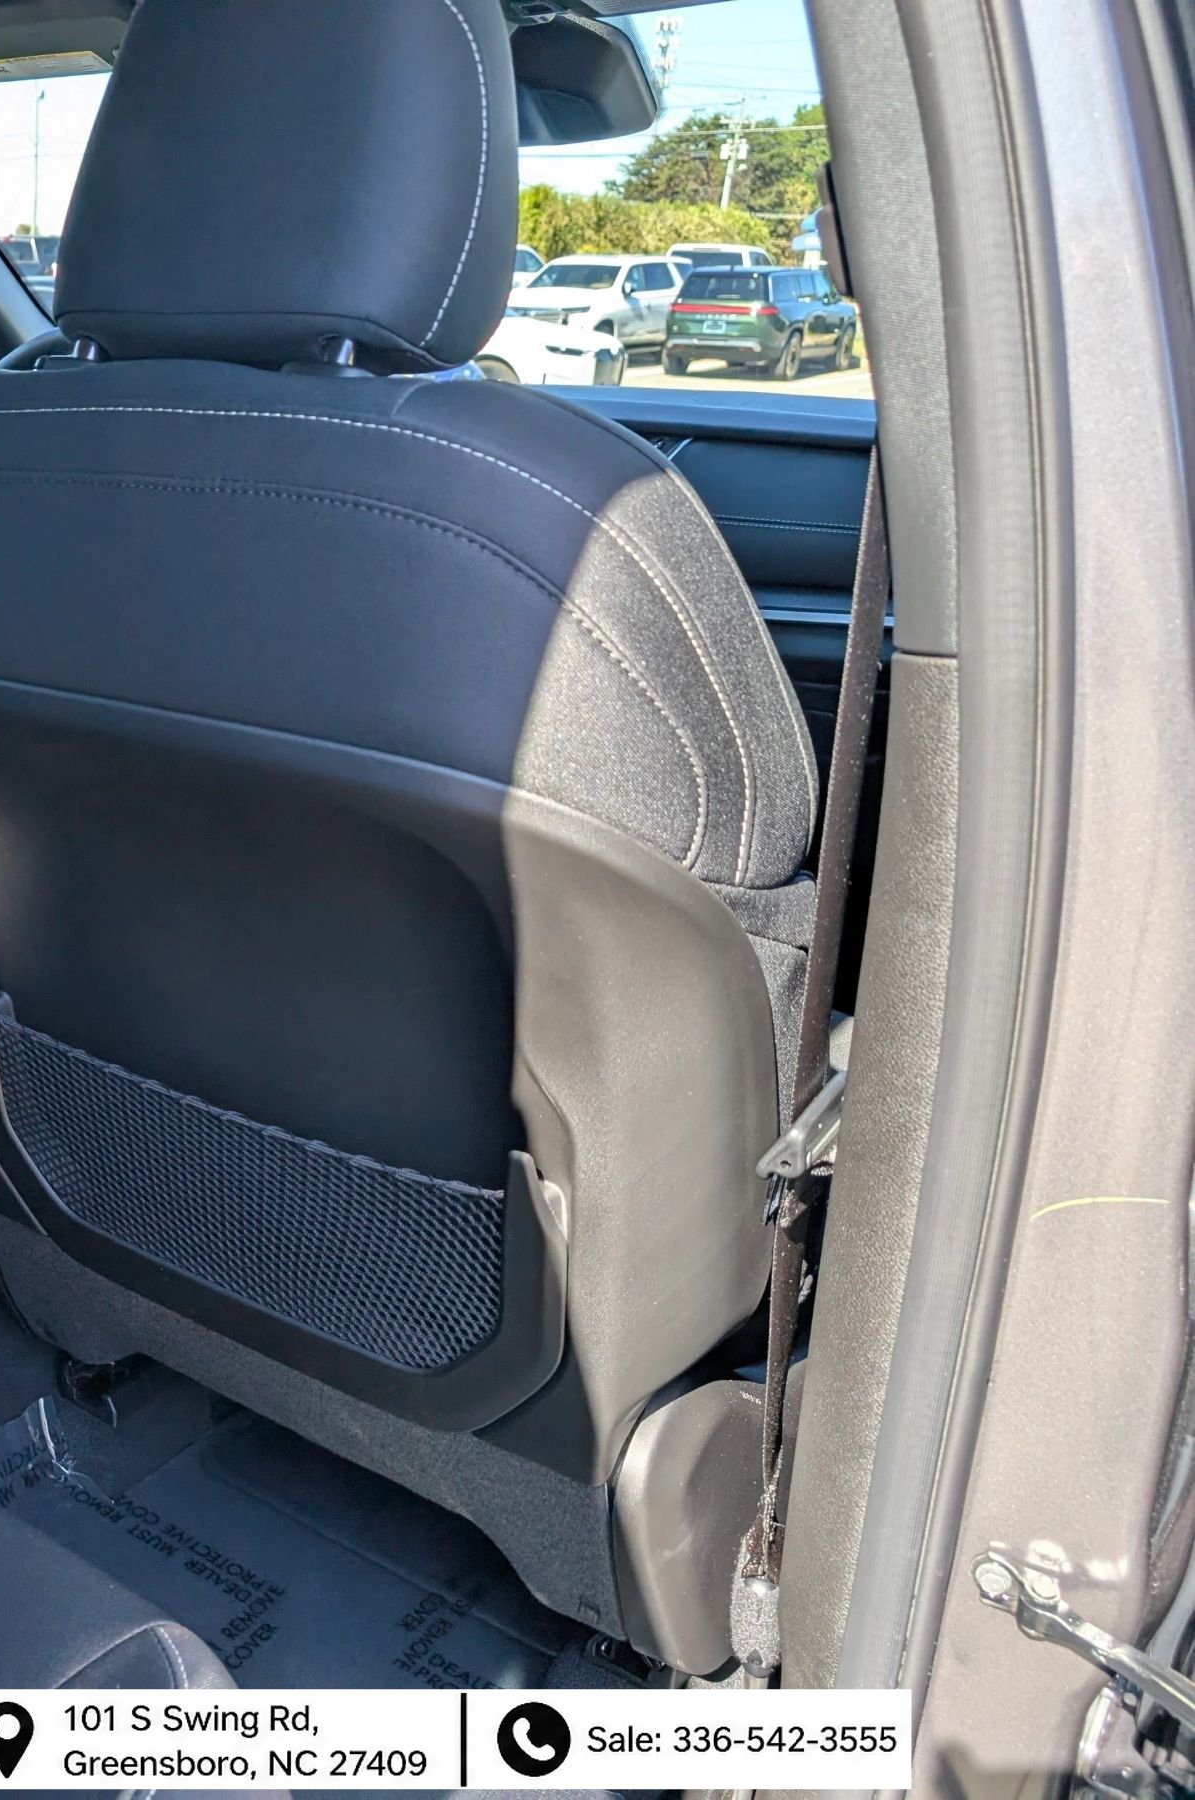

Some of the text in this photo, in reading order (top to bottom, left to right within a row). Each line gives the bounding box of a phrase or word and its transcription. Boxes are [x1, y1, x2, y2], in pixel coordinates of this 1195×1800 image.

[64, 1485, 252, 1603] DEALER MUST REMOV
[161, 1524, 273, 1591] PROTECTIVE
[221, 1585, 285, 1640] REMOVE
[225, 1623, 281, 1670] COVER
